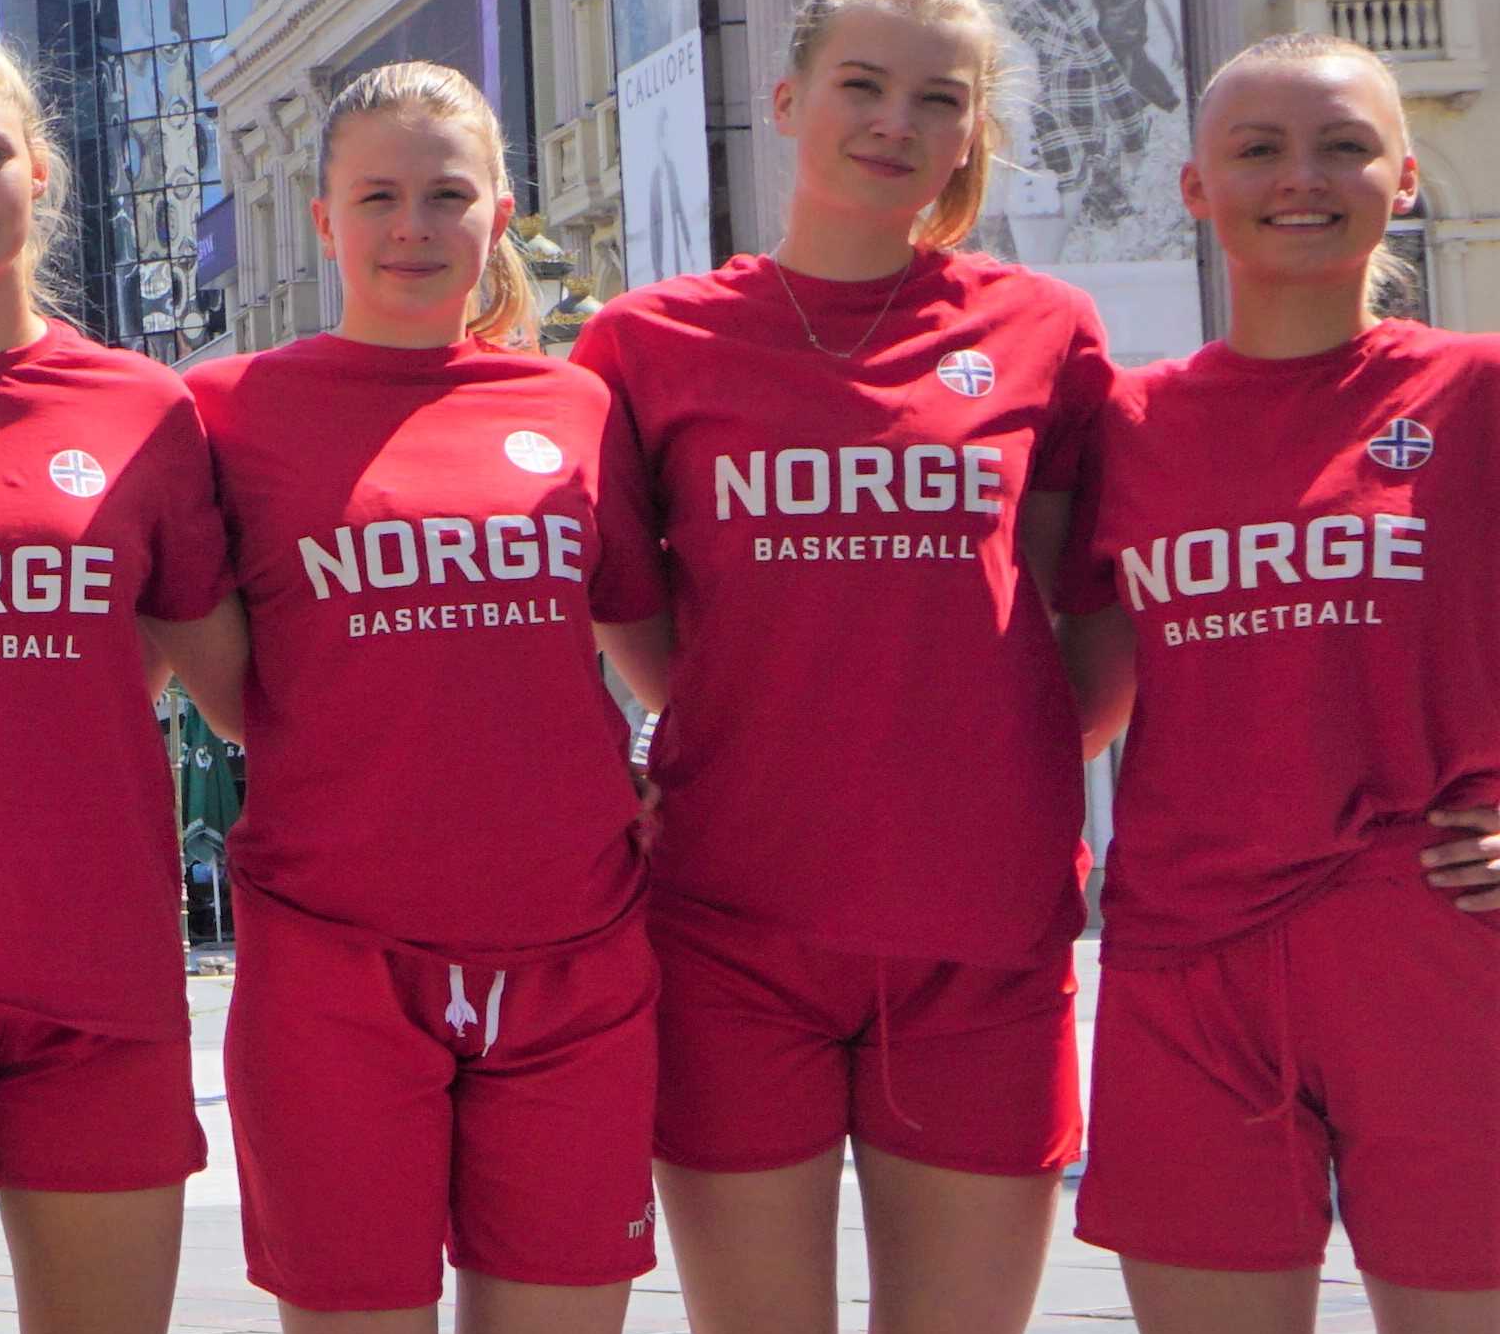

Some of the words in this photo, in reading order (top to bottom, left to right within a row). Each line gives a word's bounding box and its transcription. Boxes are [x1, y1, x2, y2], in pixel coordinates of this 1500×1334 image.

[625, 41, 696, 109] CALLIOPE
[716, 445, 1002, 519] NORGE
[299, 515, 581, 599] NORGE
[755, 536, 974, 560] BASKETBALL
[1123, 514, 1425, 610] NORGE
[351, 599, 564, 636] BASKETBALL
[1164, 601, 1381, 646] BASKETBALL
